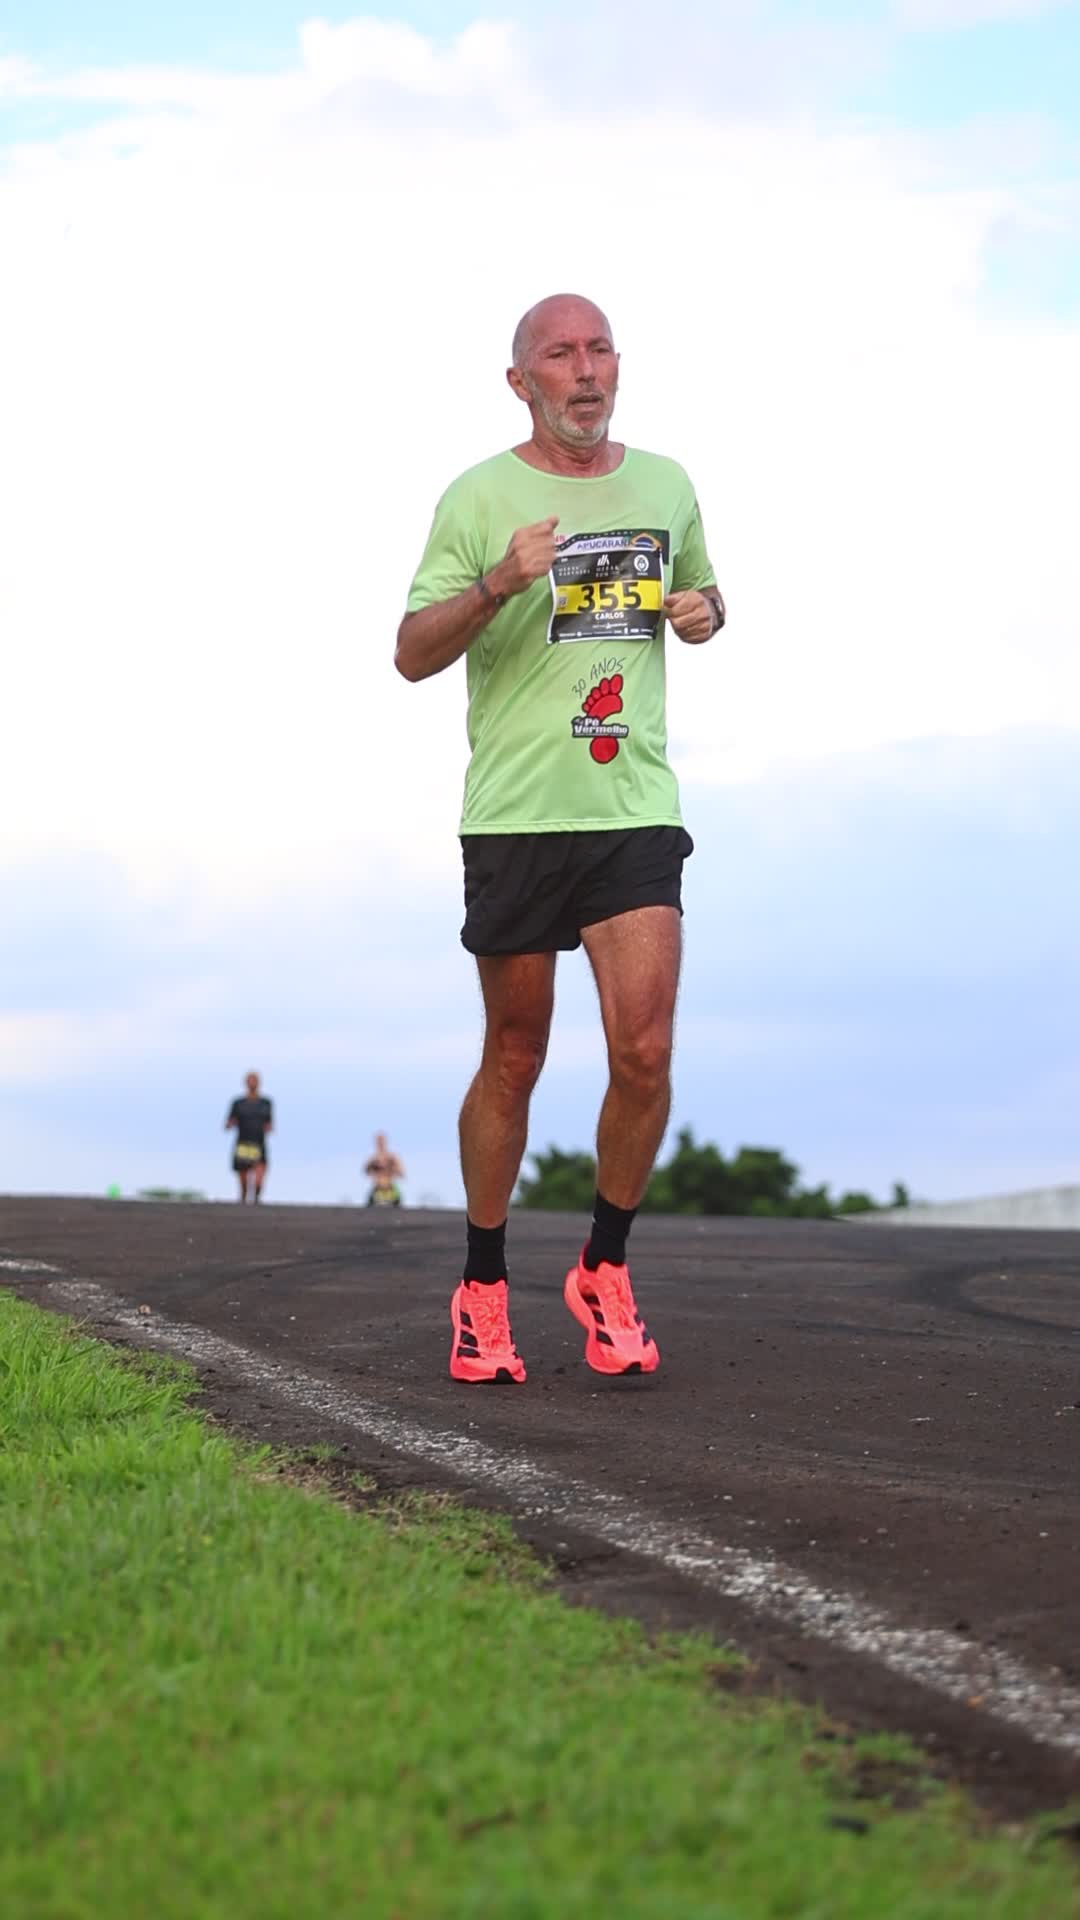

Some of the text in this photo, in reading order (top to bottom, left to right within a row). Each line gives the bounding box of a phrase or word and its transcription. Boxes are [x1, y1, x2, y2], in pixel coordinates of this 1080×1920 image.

[577, 582, 642, 613] 355
[595, 612, 625, 620] CARLOS
[572, 657, 626, 698] 30 ANOS
[574, 725, 628, 735] Vermelho
